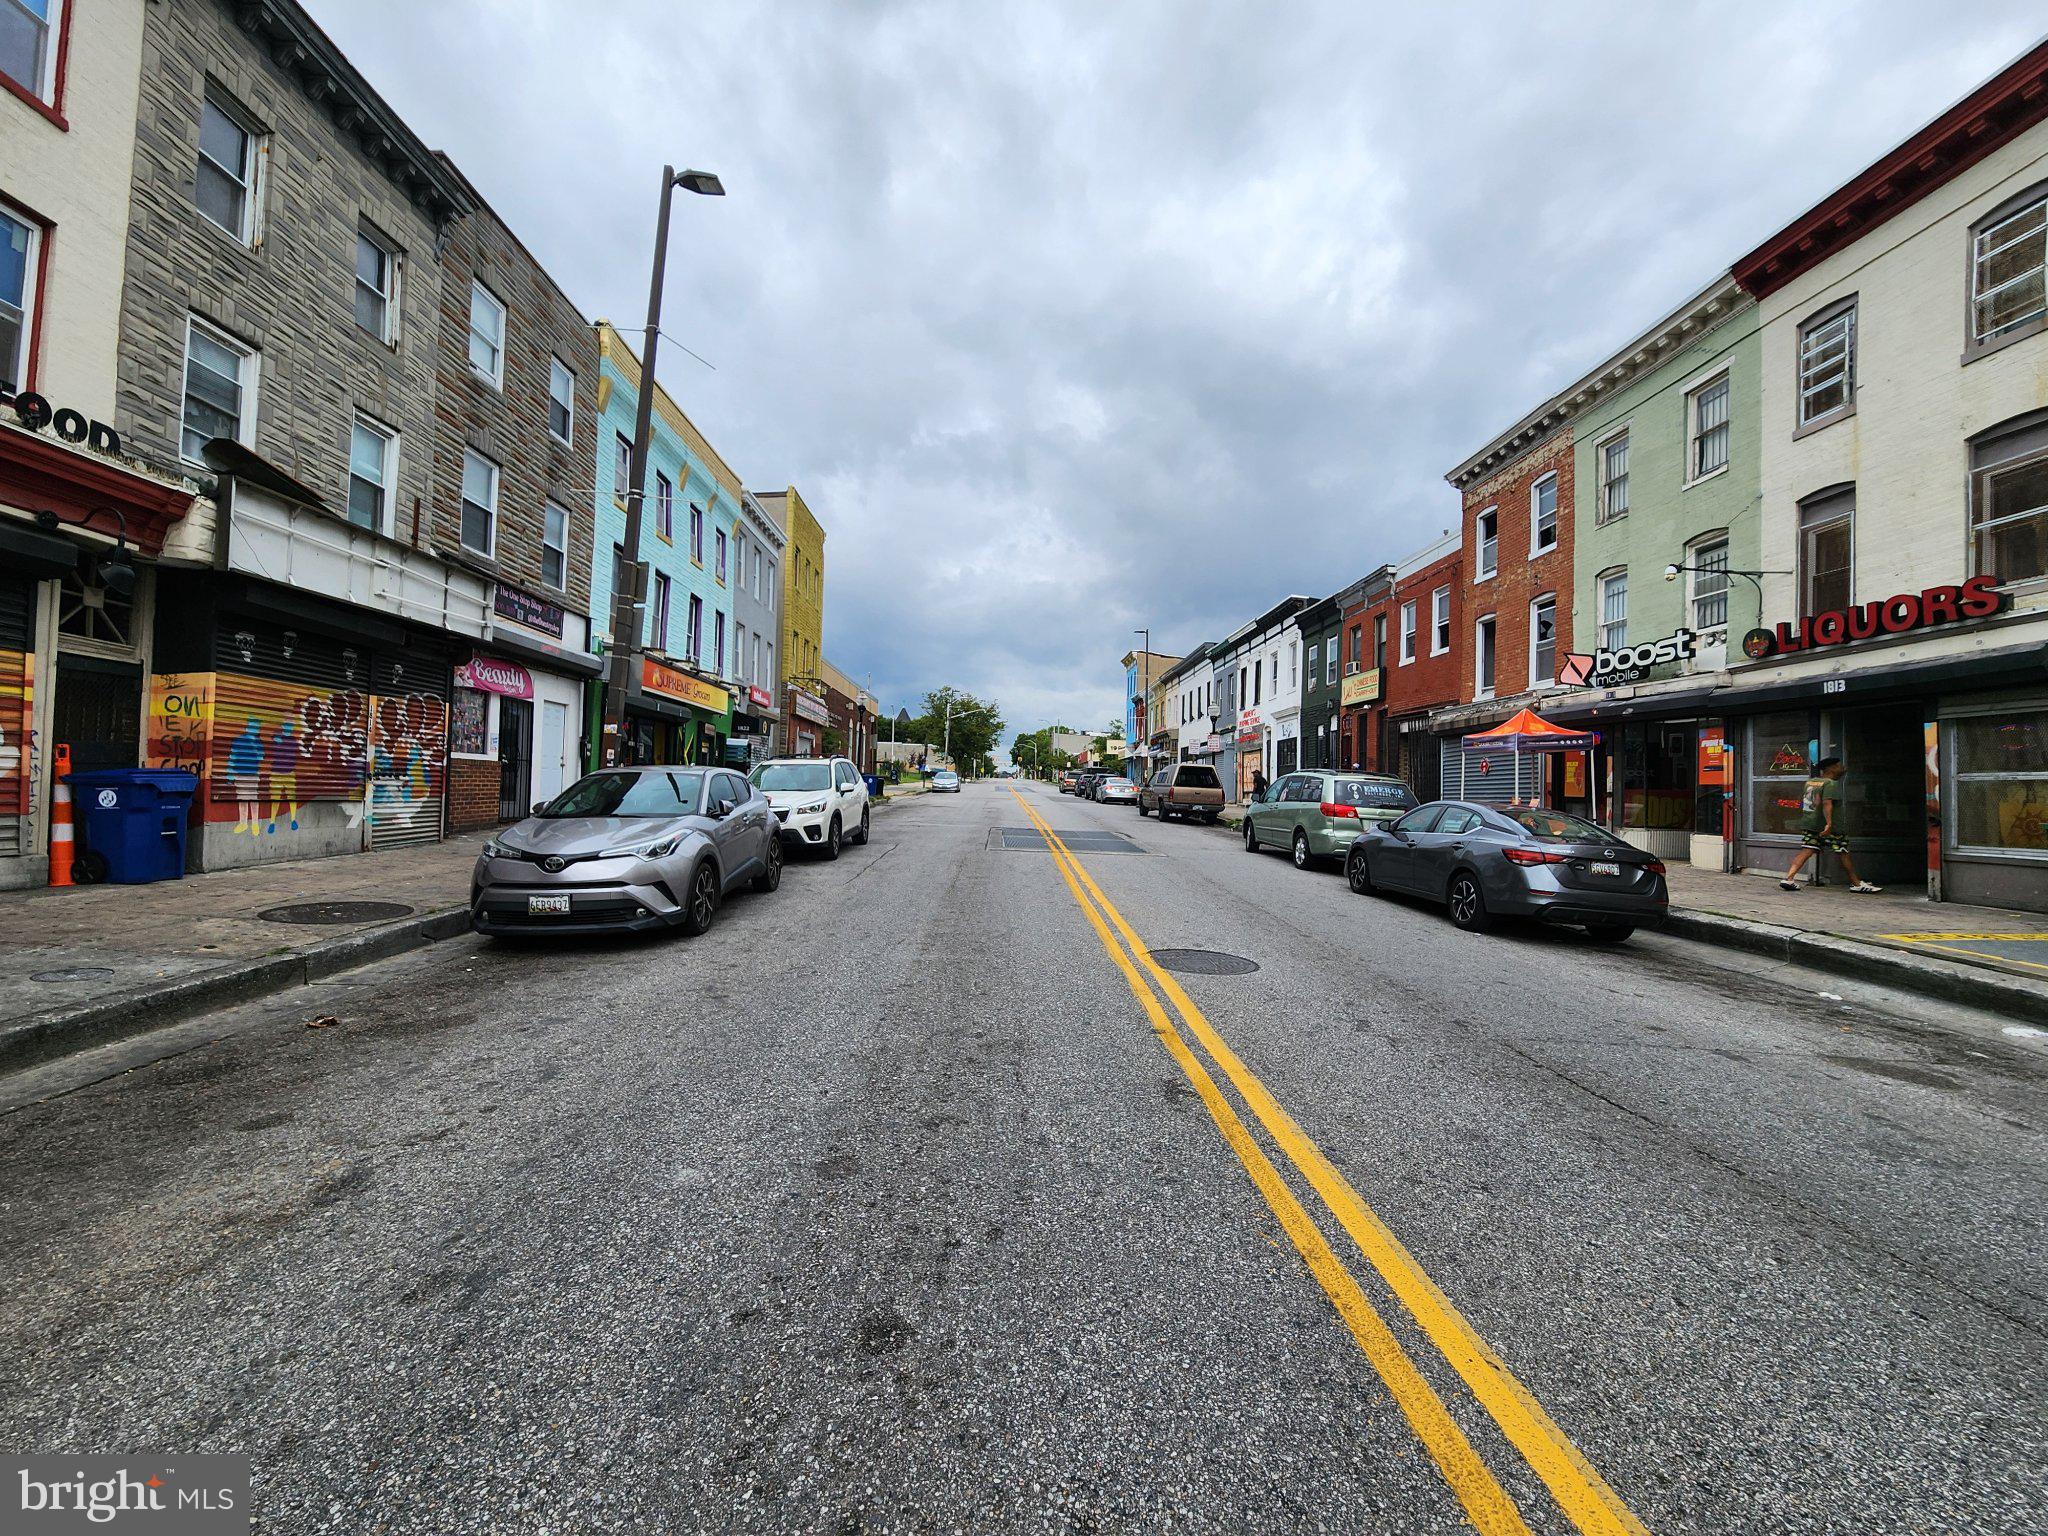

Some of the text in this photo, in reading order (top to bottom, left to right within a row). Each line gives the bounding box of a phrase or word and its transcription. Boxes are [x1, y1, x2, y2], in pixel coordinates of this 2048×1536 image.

[1777, 575, 1999, 653] LIQUORS
[1596, 629, 1690, 674] boost
[471, 657, 526, 695] Beauty
[655, 673, 692, 696] SUPREME
[1597, 669, 1640, 687] mobile
[1823, 679, 1847, 694] 1813
